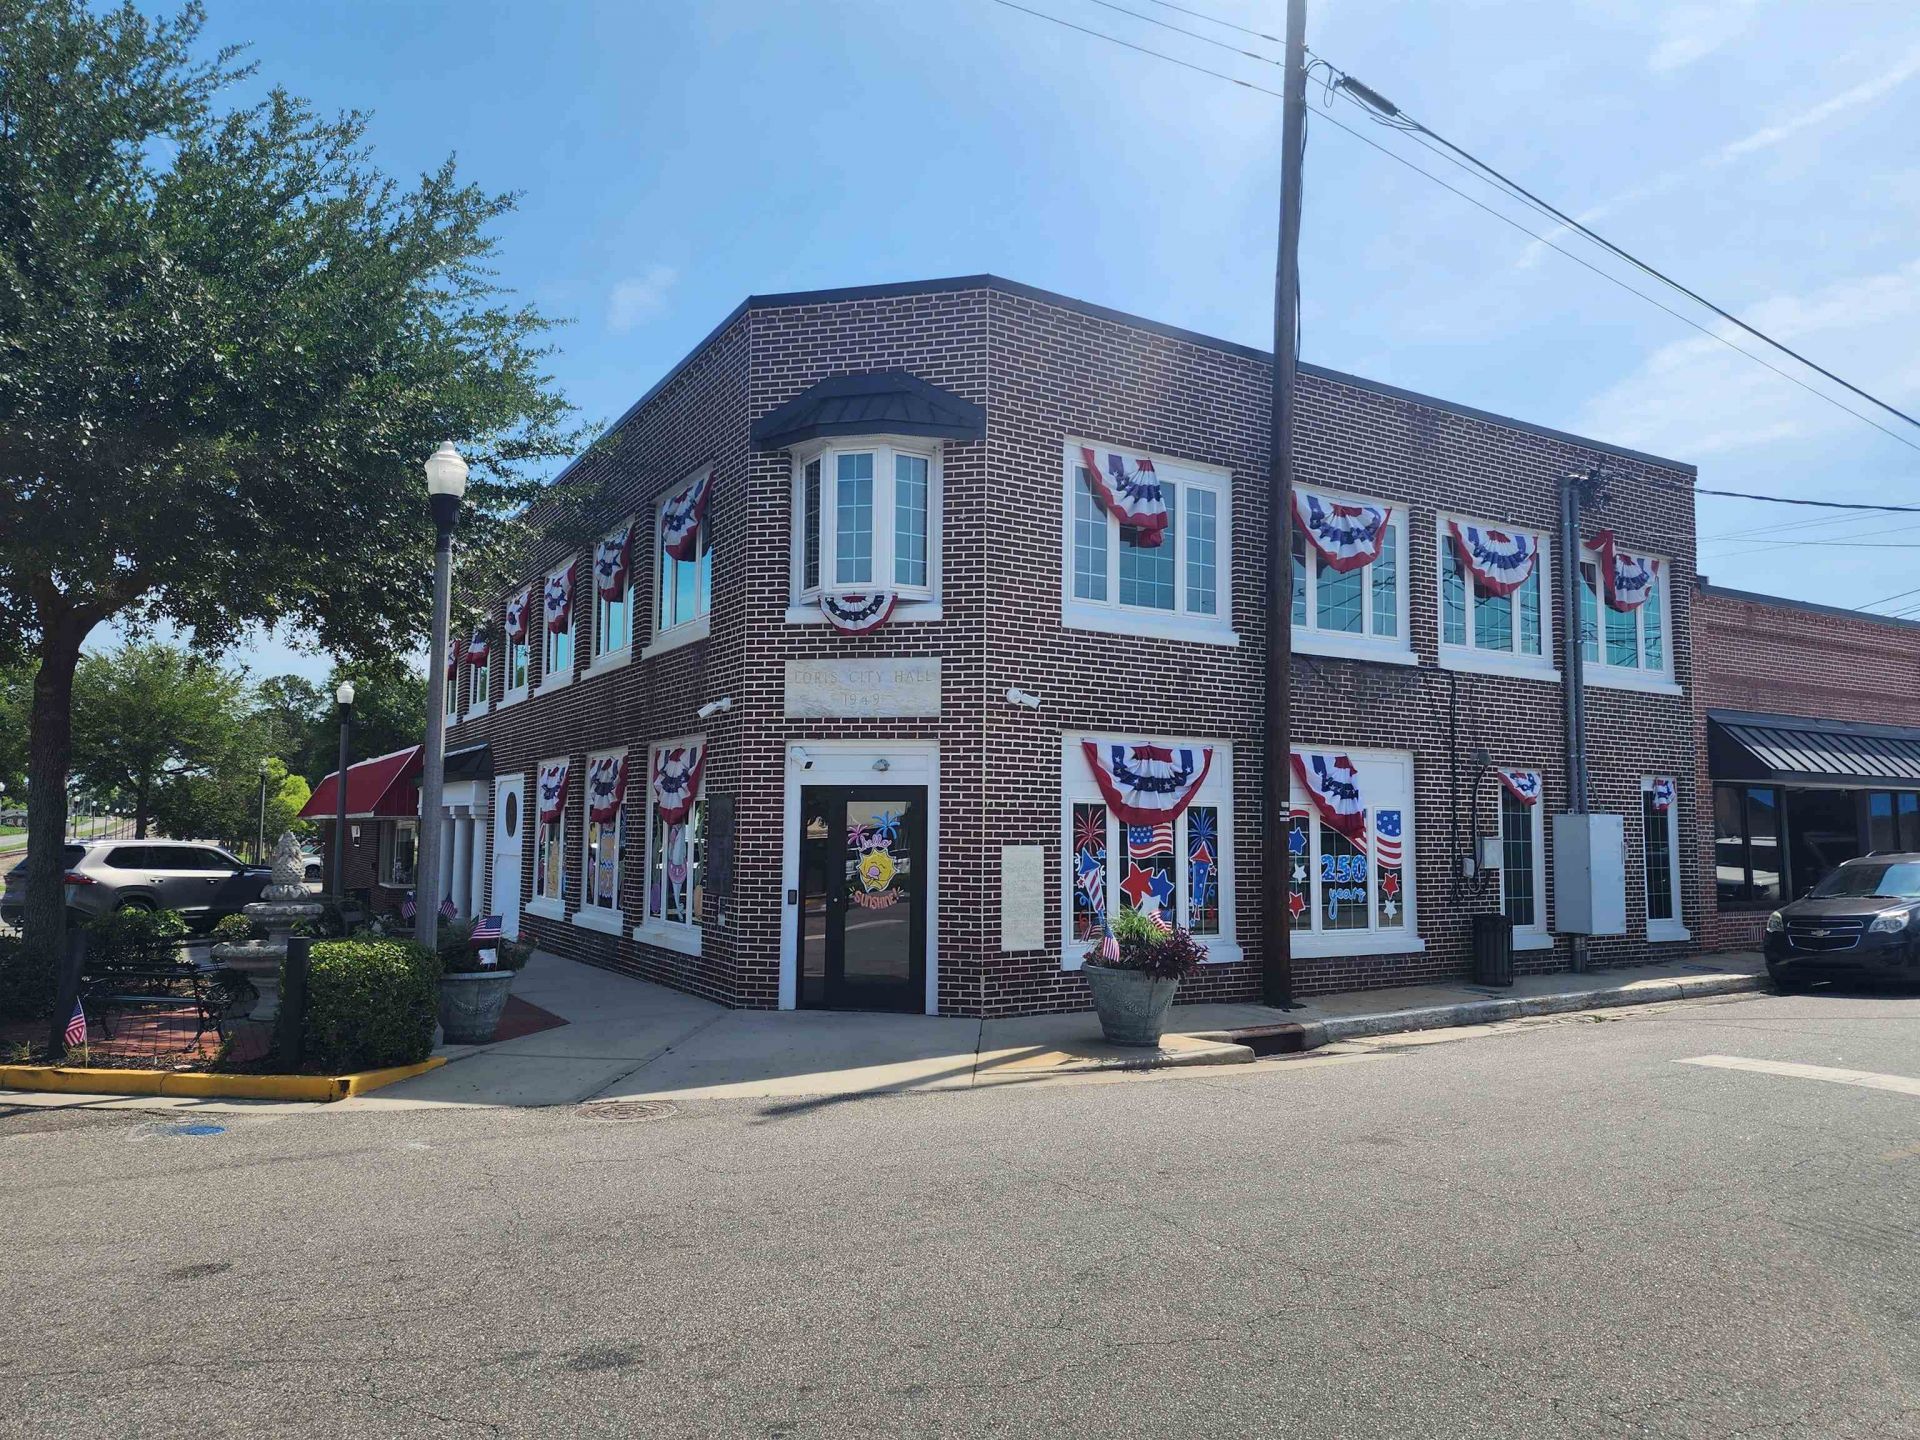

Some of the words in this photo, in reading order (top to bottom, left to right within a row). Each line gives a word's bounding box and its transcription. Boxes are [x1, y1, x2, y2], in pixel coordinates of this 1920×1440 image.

[794, 671, 839, 684] LORIS
[849, 671, 882, 684] CITY
[894, 670, 933, 683] HALL
[843, 693, 880, 706] 1949
[859, 833, 892, 850] hello
[1321, 853, 1367, 883] 250
[1328, 888, 1366, 920] years
